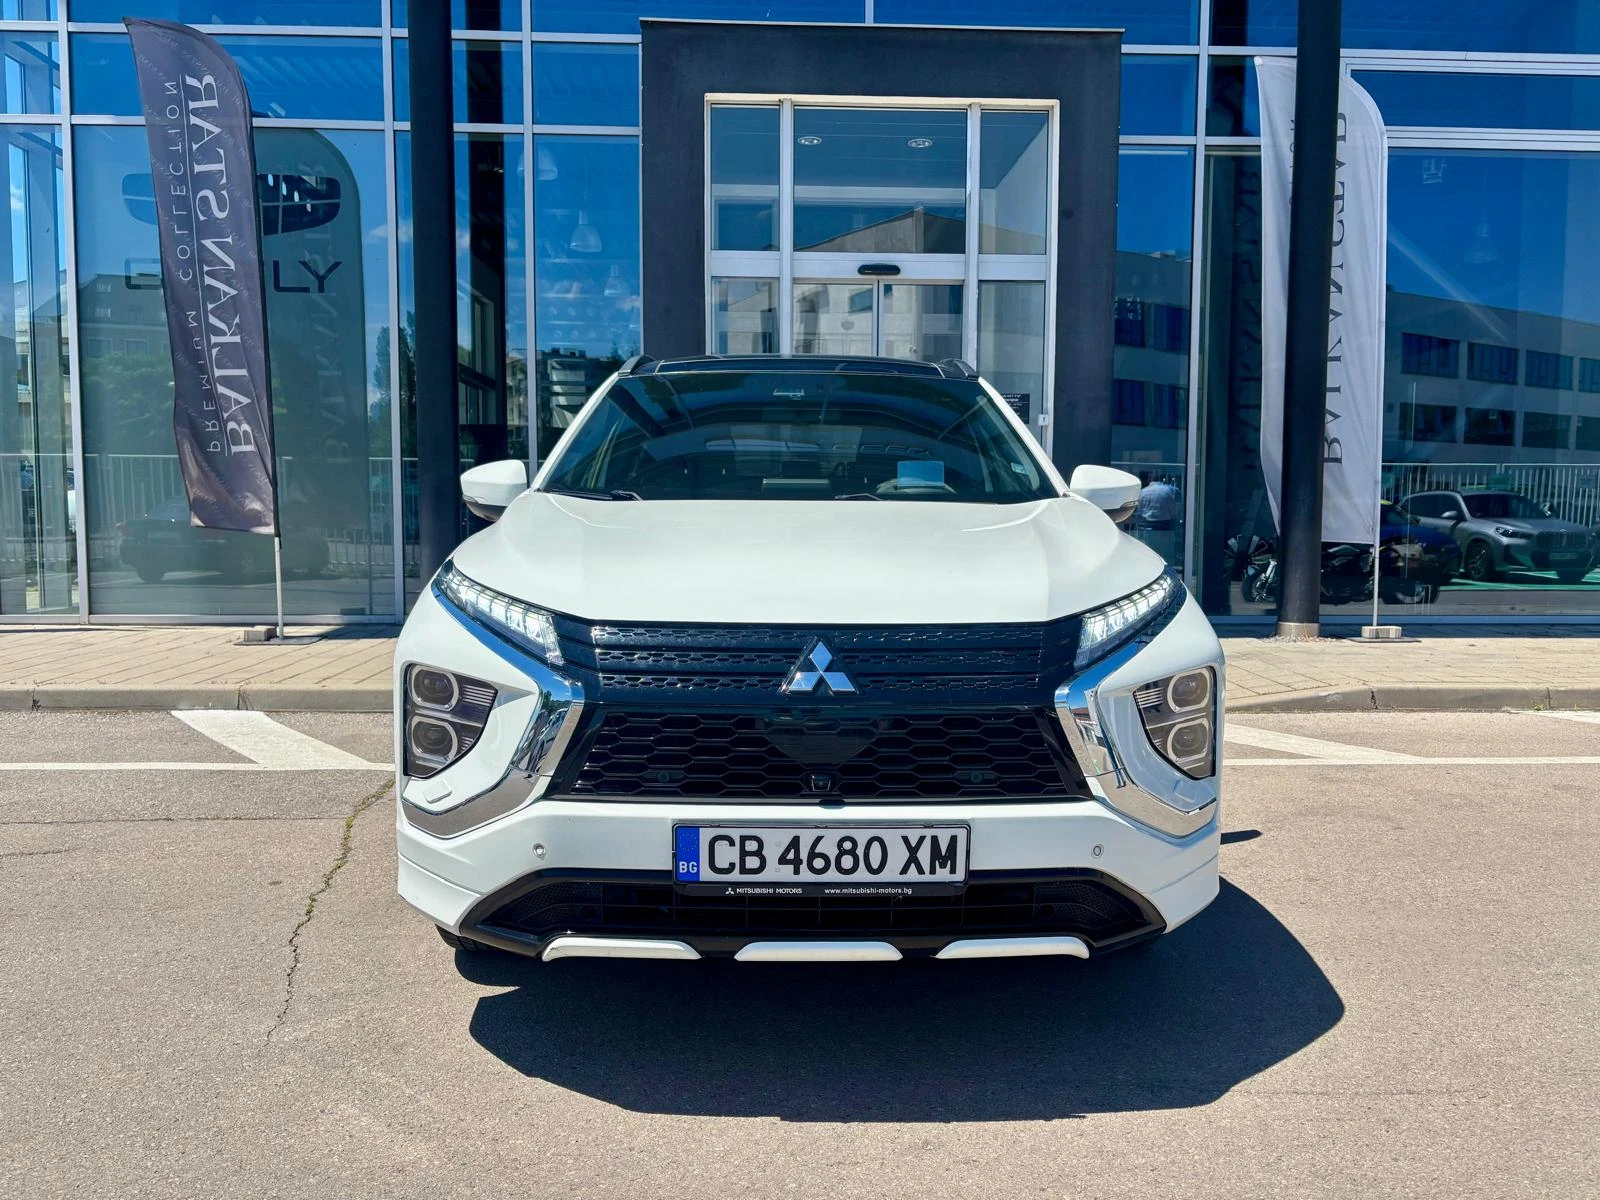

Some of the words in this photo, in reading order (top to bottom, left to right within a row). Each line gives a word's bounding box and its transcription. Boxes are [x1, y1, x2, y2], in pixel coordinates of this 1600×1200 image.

[708, 834, 767, 876] CB
[777, 835, 889, 876] 4680
[899, 834, 958, 876] XM
[679, 861, 698, 873] BG
[824, 887, 913, 895] www.mitsubishi-motors.bg
